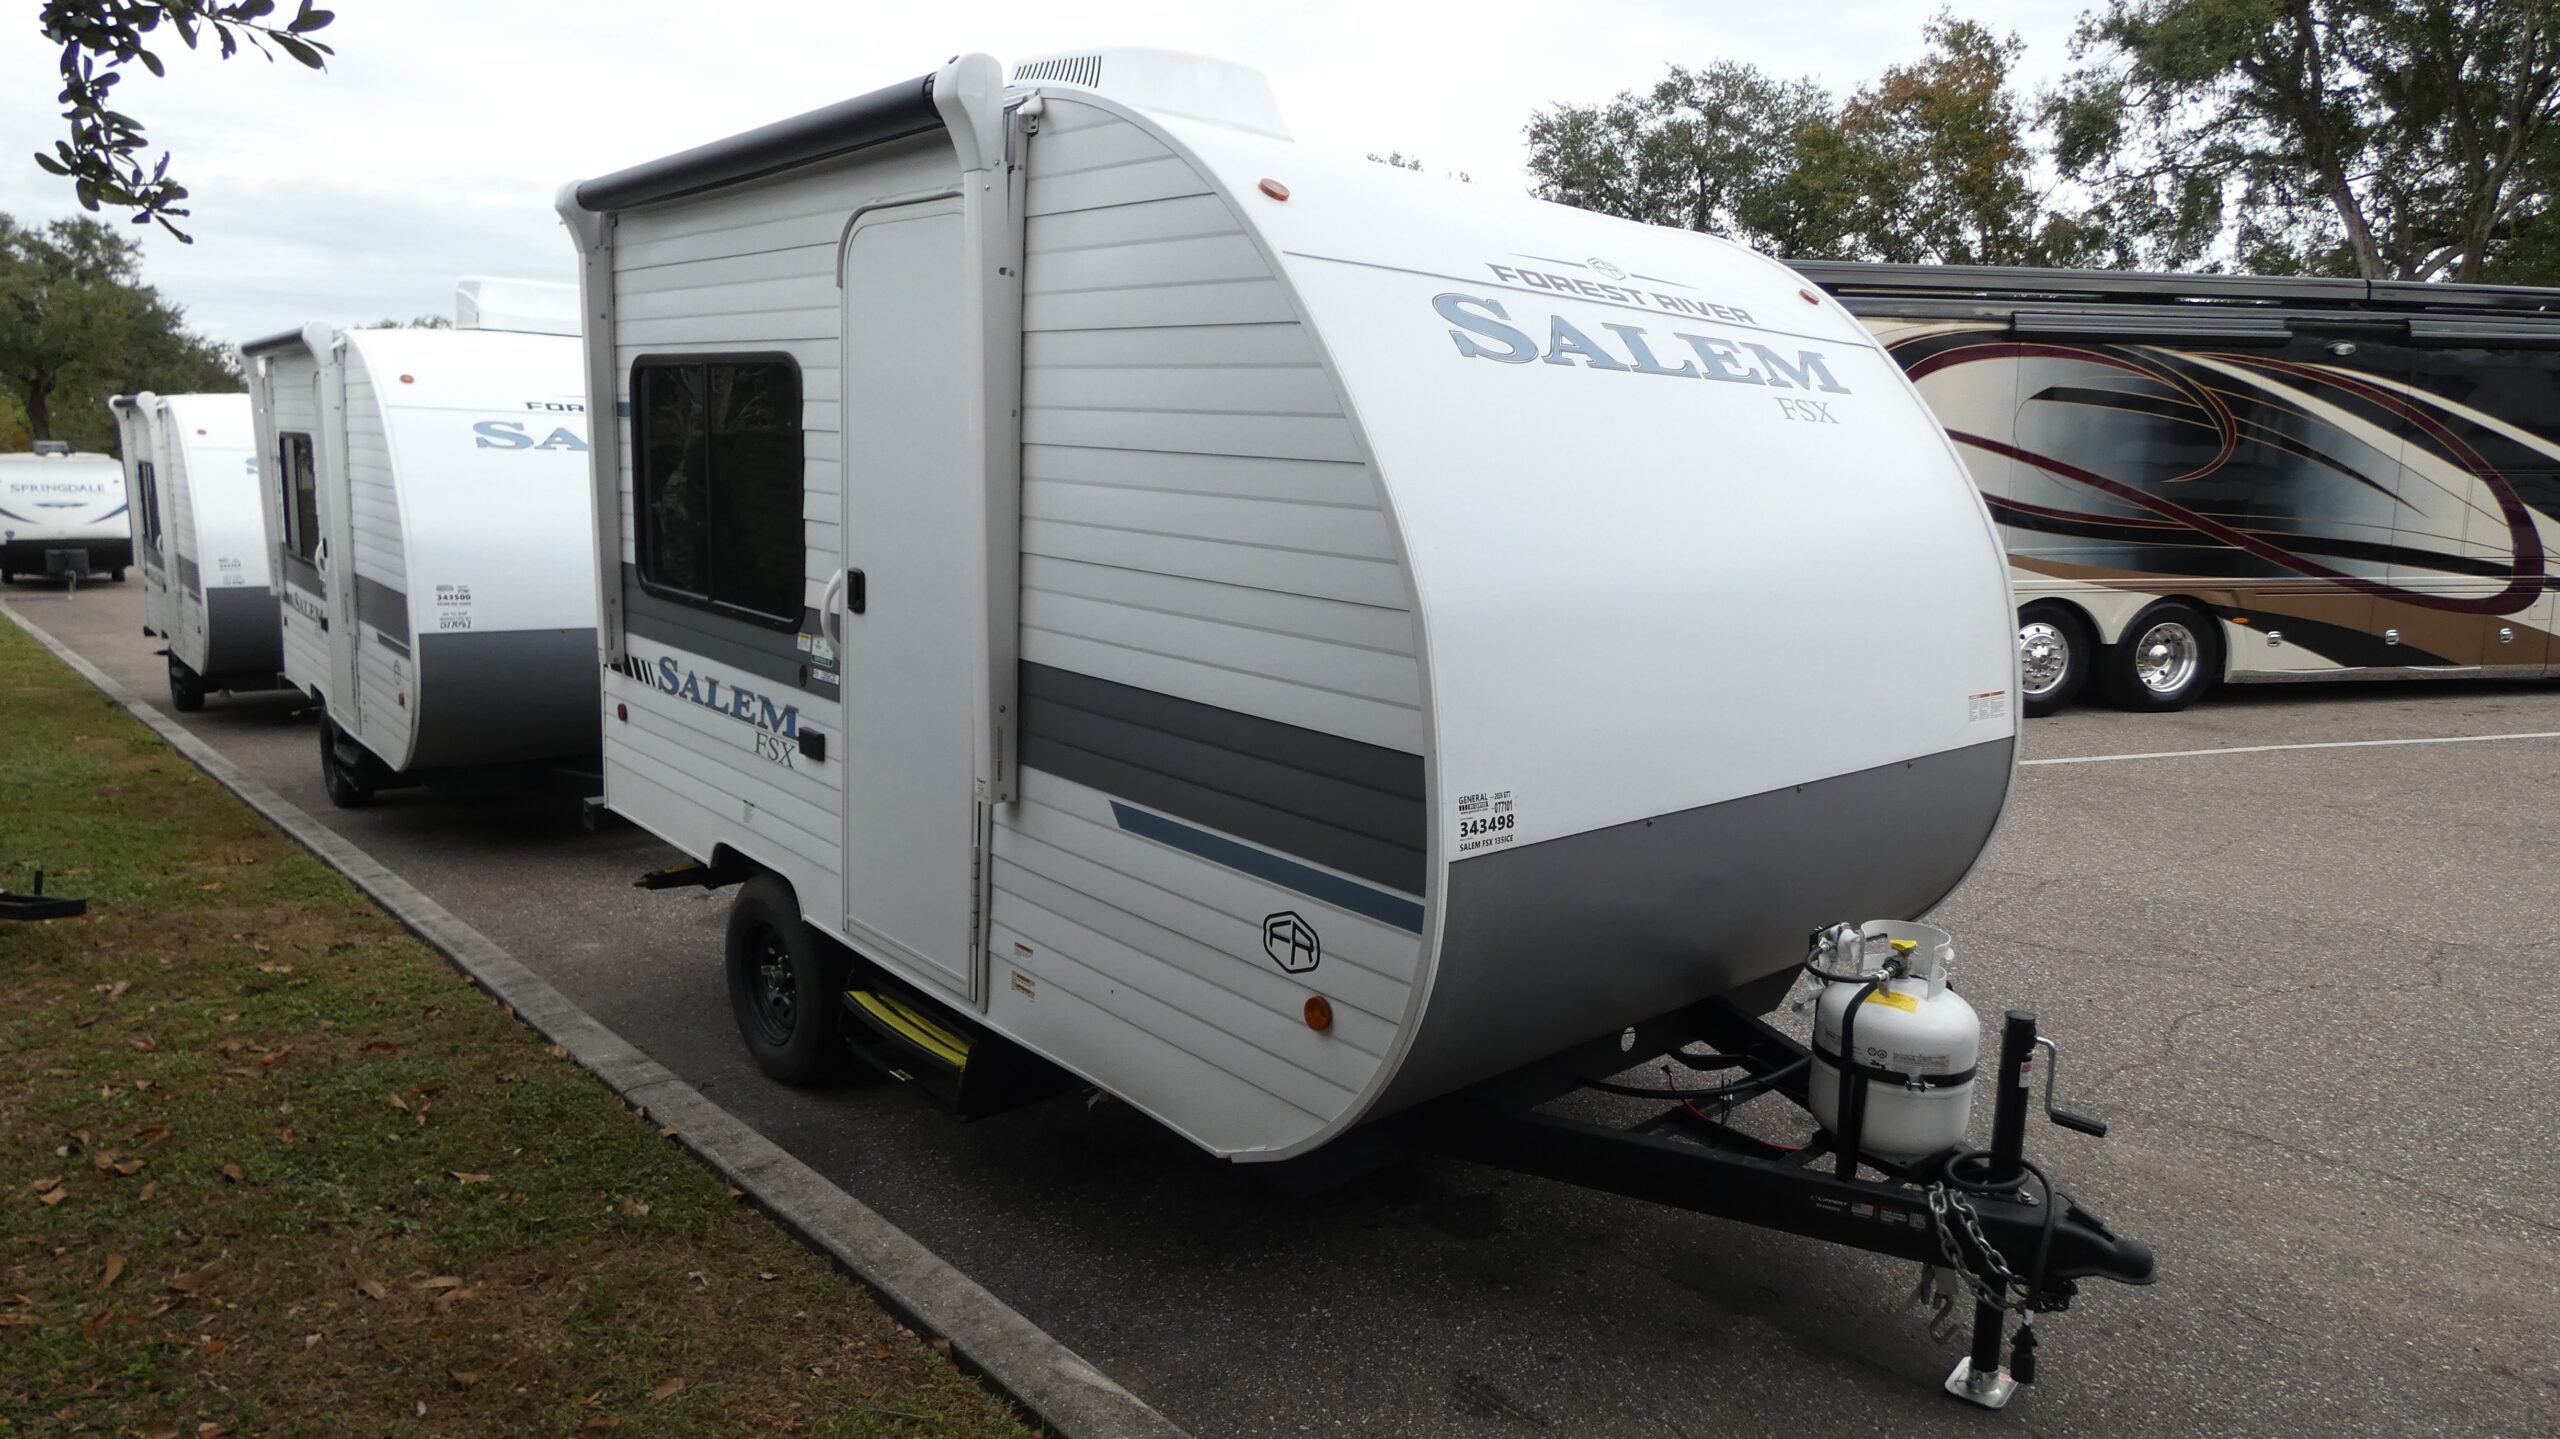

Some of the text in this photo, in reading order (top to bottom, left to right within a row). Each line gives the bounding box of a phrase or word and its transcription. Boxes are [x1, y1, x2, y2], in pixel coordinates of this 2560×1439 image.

[1485, 263, 1647, 306] FOREST
[1659, 292, 1758, 325] RIVER
[1432, 292, 1852, 394] SALEM
[1773, 397, 1840, 424] FSX
[10, 483, 105, 493] SPRINGDALE
[658, 656, 800, 740] SALEM
[753, 731, 796, 769] FSX
[1458, 793, 1488, 804] GENERAL
[1460, 814, 1514, 837] 343498
[1459, 841, 1481, 852] SALEM
[1482, 838, 1493, 847] FSX
